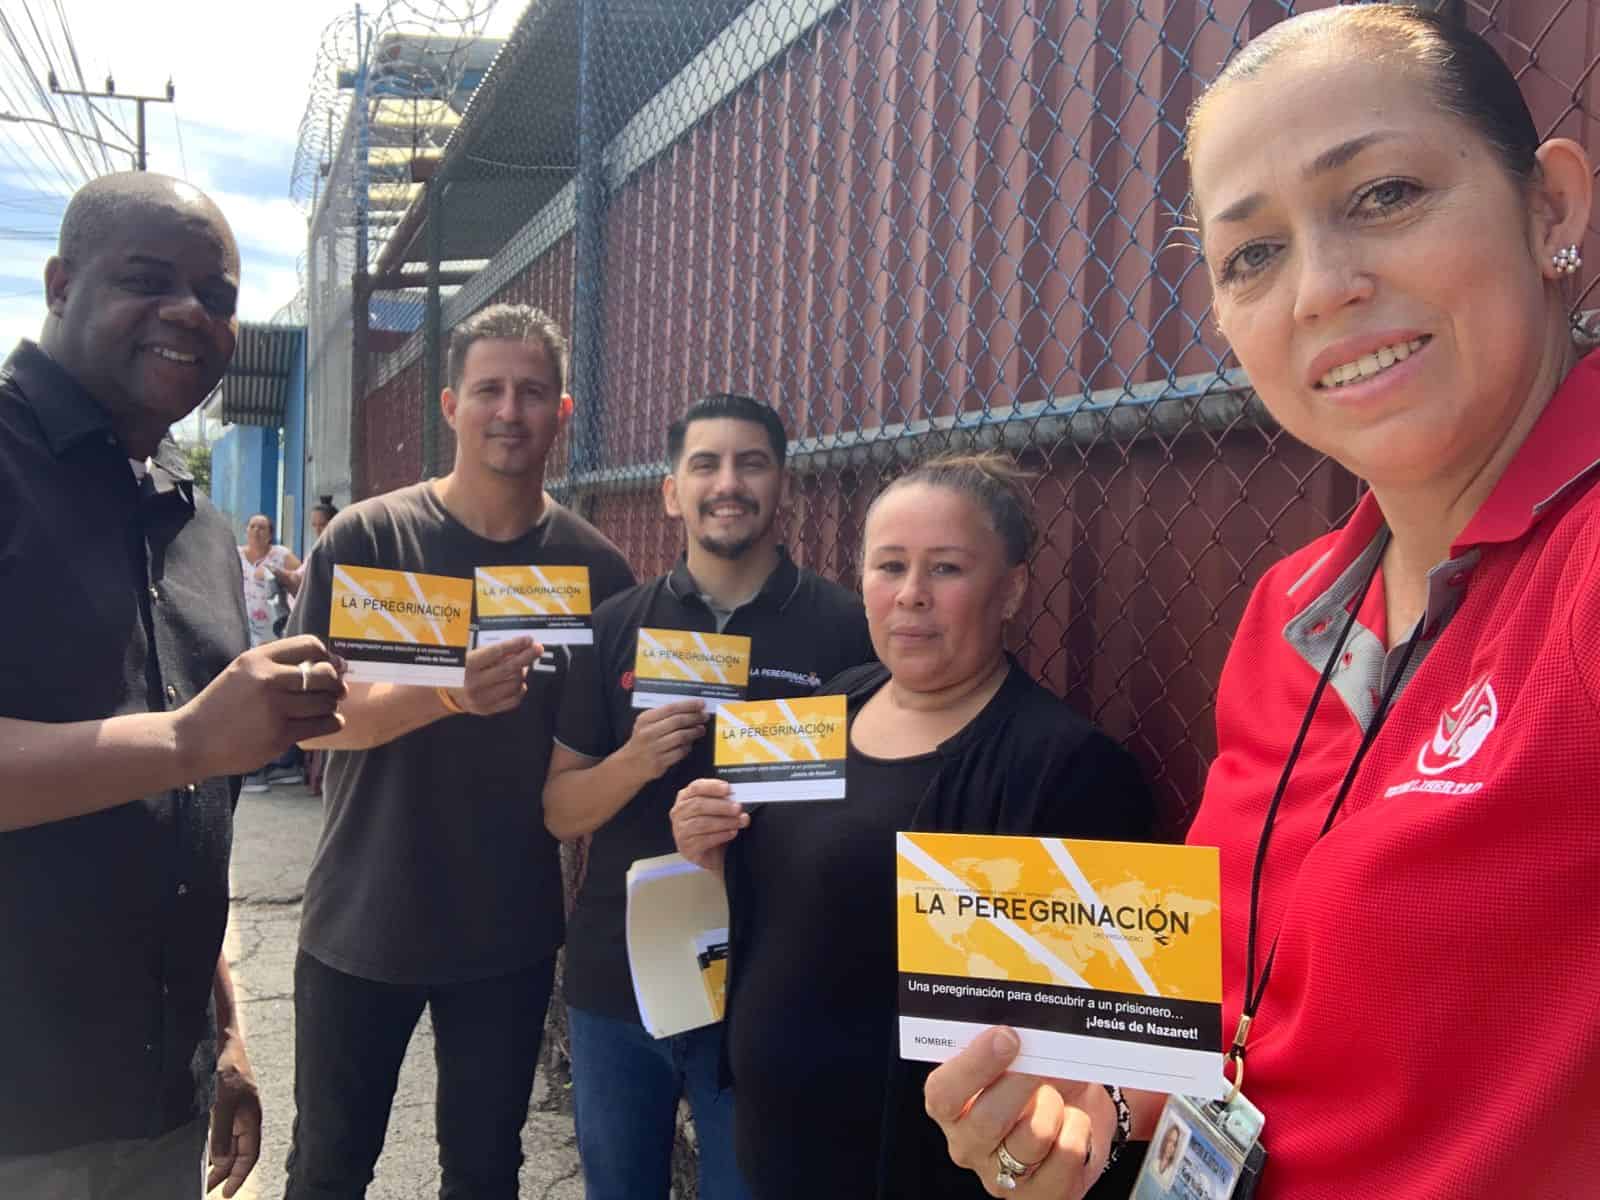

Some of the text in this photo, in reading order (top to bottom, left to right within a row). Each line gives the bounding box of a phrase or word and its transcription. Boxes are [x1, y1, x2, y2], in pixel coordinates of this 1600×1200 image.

[341, 597, 461, 617] LA PEREGRINACIÓN
[722, 722, 834, 739] LA PEREGRINACIÓN
[915, 892, 945, 915] LA
[958, 895, 1190, 935] PEREGRINACIÓN
[908, 980, 930, 992] Una
[932, 984, 1005, 998] peregrinación
[1007, 990, 1032, 1001] para
[1034, 992, 1085, 1007] descubrir
[1087, 999, 1095, 1009] a
[1098, 1000, 1112, 1010] un
[1086, 1015, 1199, 1040] ¡Jesús de Nazaret!
[914, 1036, 956, 1048] NOMBRE:
